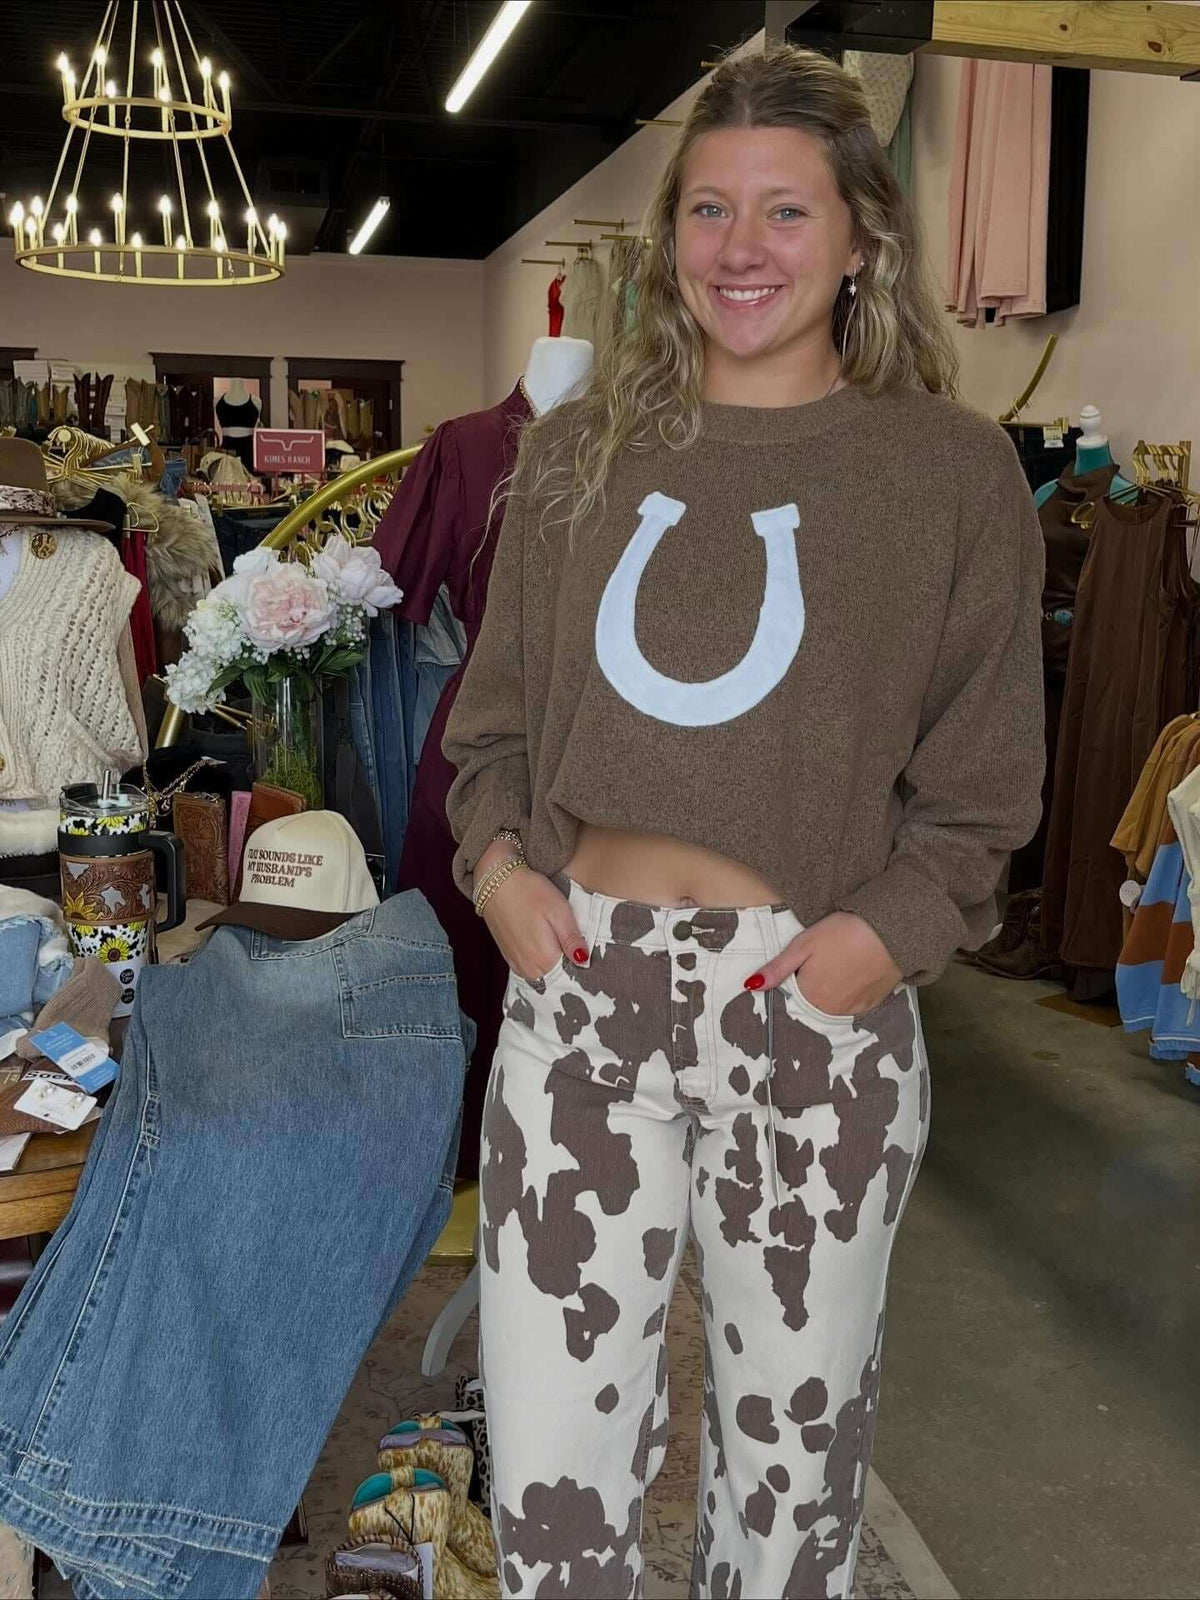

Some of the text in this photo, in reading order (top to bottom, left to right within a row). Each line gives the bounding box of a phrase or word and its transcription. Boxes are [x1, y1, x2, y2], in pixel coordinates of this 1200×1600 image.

[264, 455, 311, 464] KIMES RANCH
[259, 850, 296, 863] SOUNDS
[297, 853, 324, 866] LIKE
[256, 862, 313, 877] HUSBAND'S
[251, 873, 295, 887] PROBLEM
